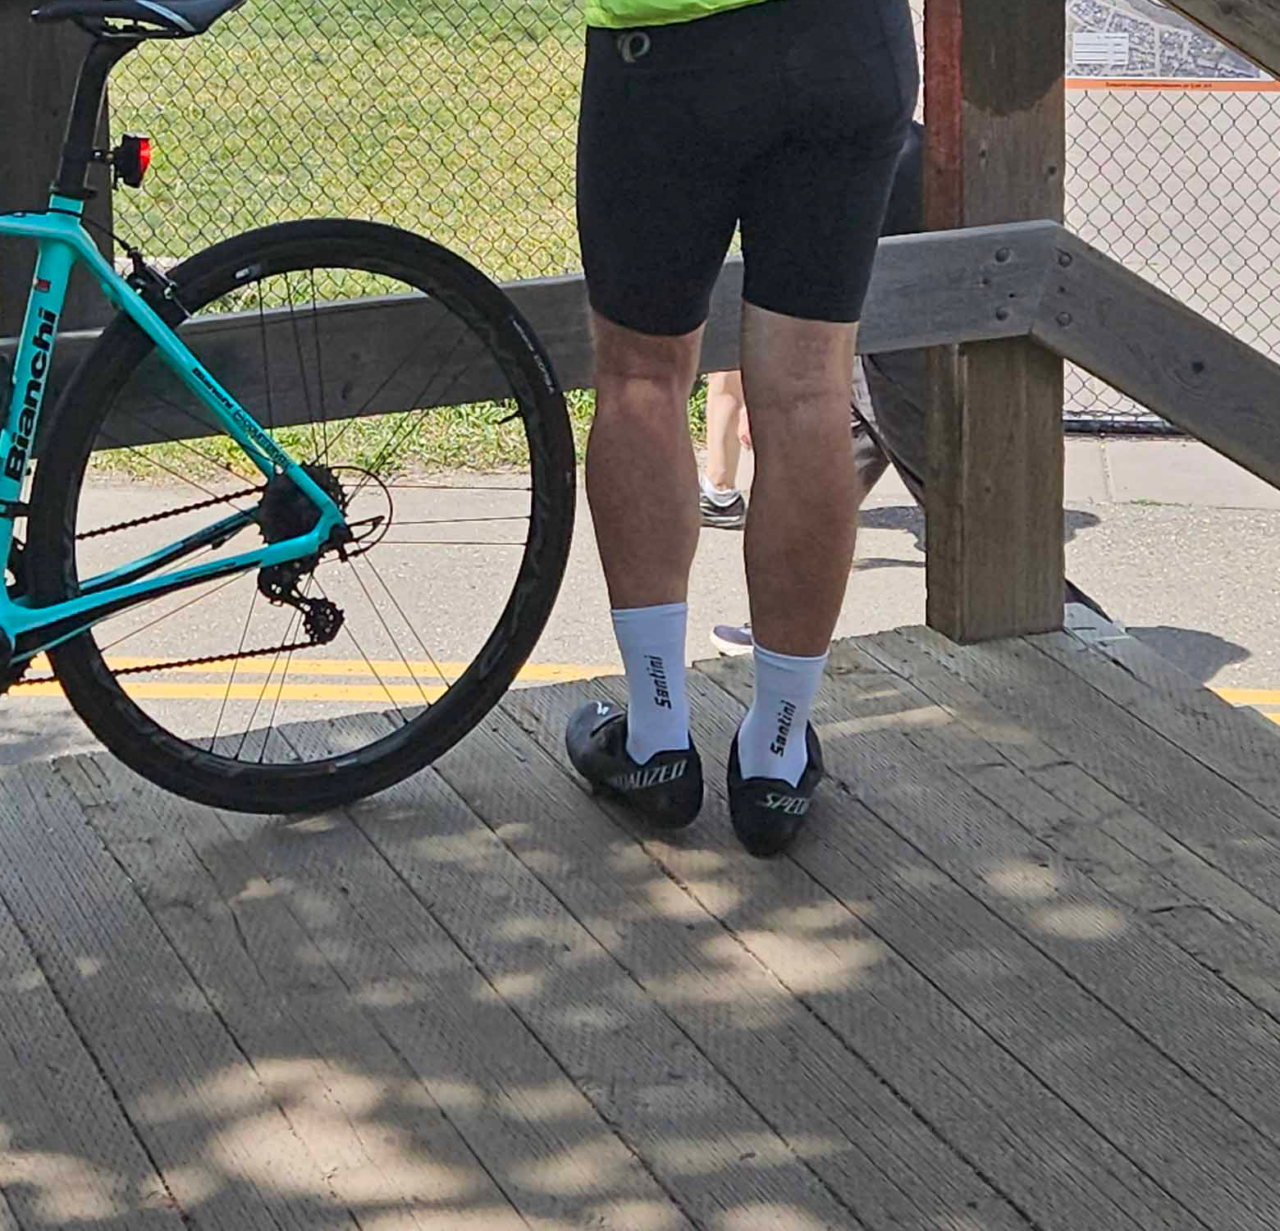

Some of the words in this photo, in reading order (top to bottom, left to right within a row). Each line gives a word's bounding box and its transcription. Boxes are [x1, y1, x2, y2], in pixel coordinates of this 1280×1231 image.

[4, 307, 58, 482] Bianchi
[644, 655, 672, 709] Santini
[770, 699, 797, 758] Santini
